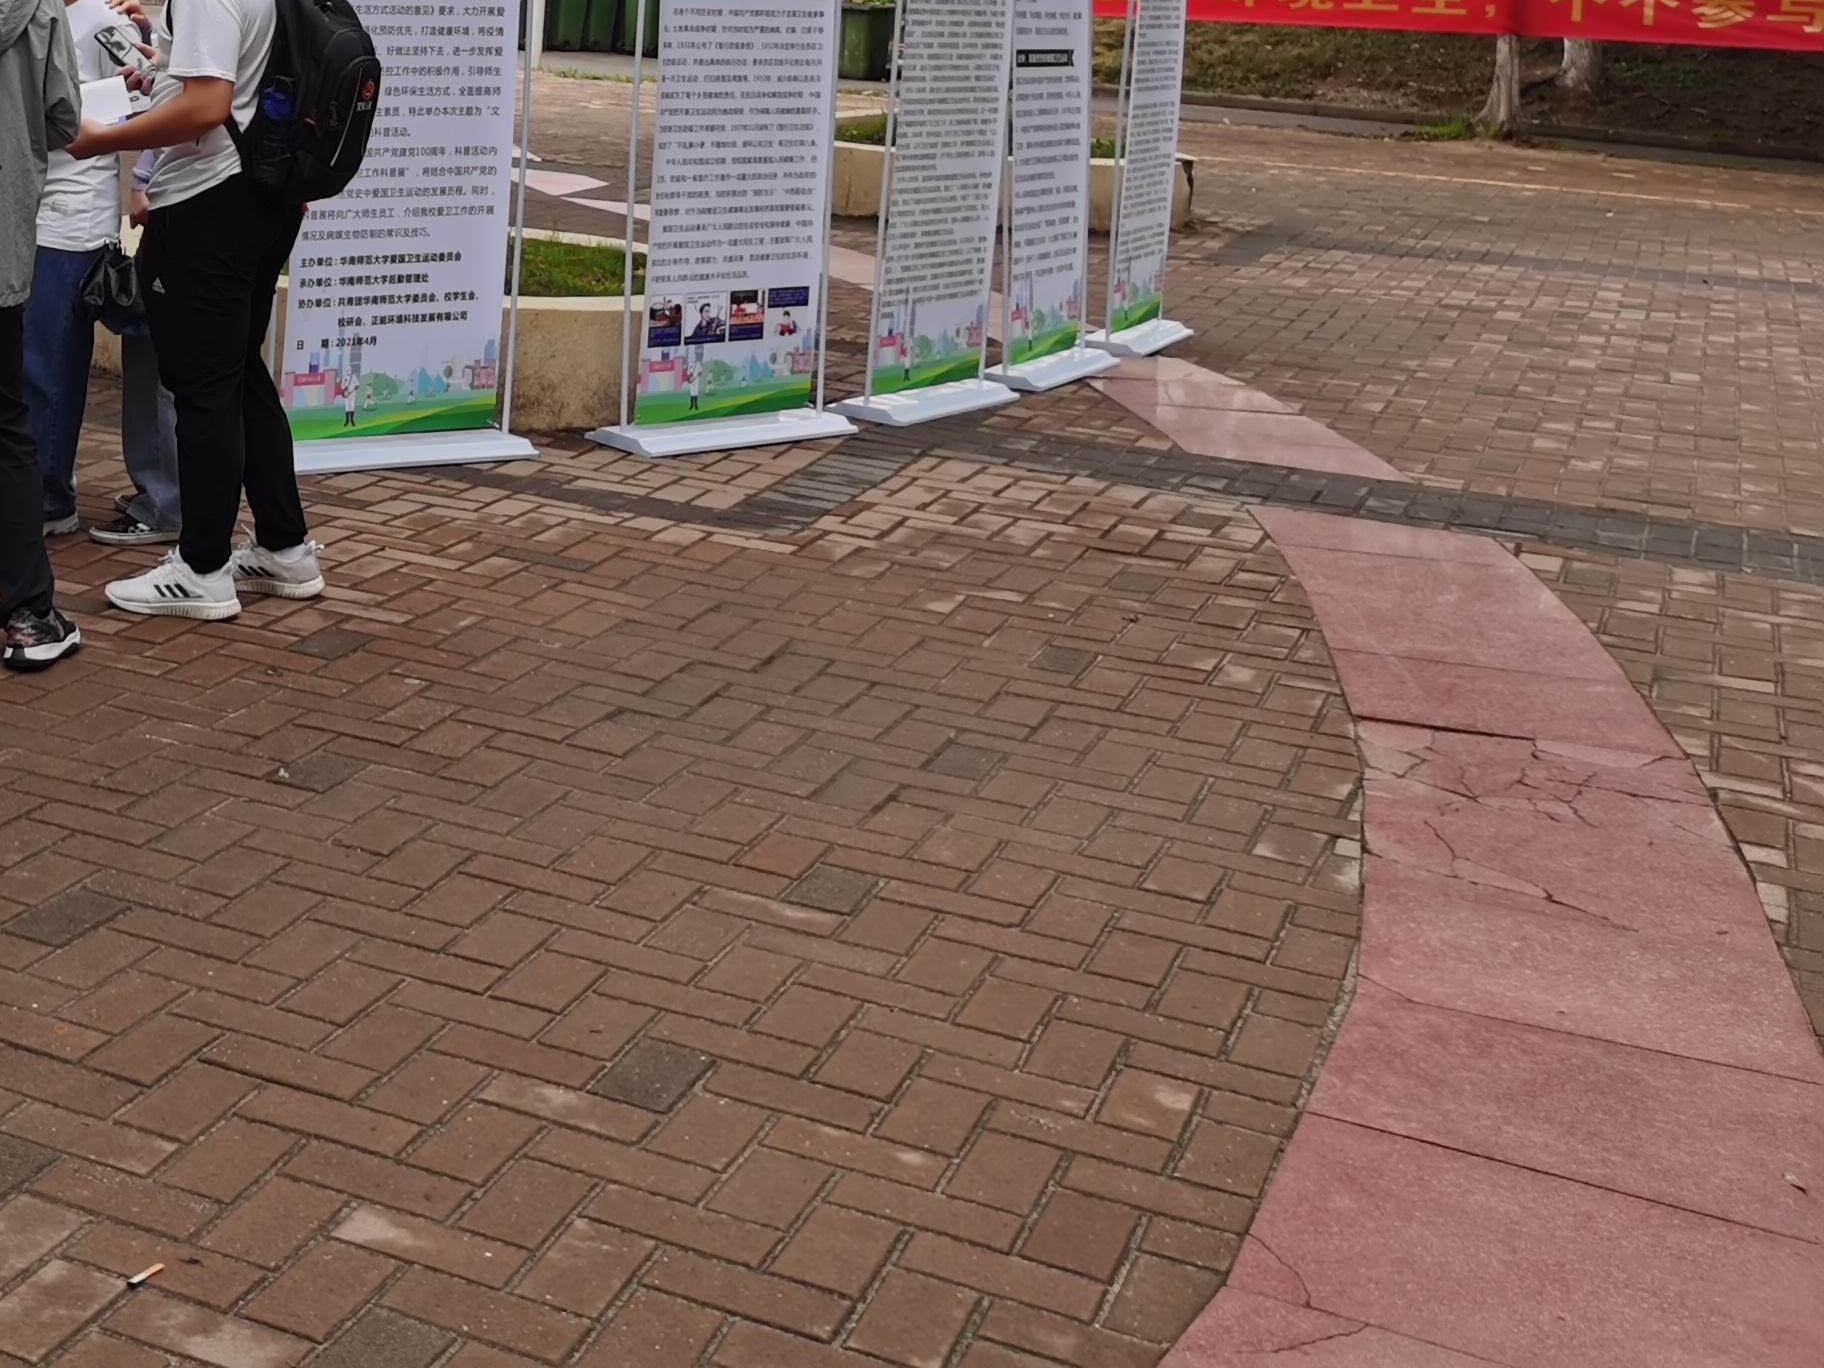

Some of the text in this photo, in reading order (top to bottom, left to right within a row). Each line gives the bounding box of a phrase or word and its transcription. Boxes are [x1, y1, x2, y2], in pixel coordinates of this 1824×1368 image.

[353, 4, 505, 18] 生活方式活动的意见》要求，大力开展爱
[376, 46, 503, 58] 、好做法坚持下去，进一步发挥爱
